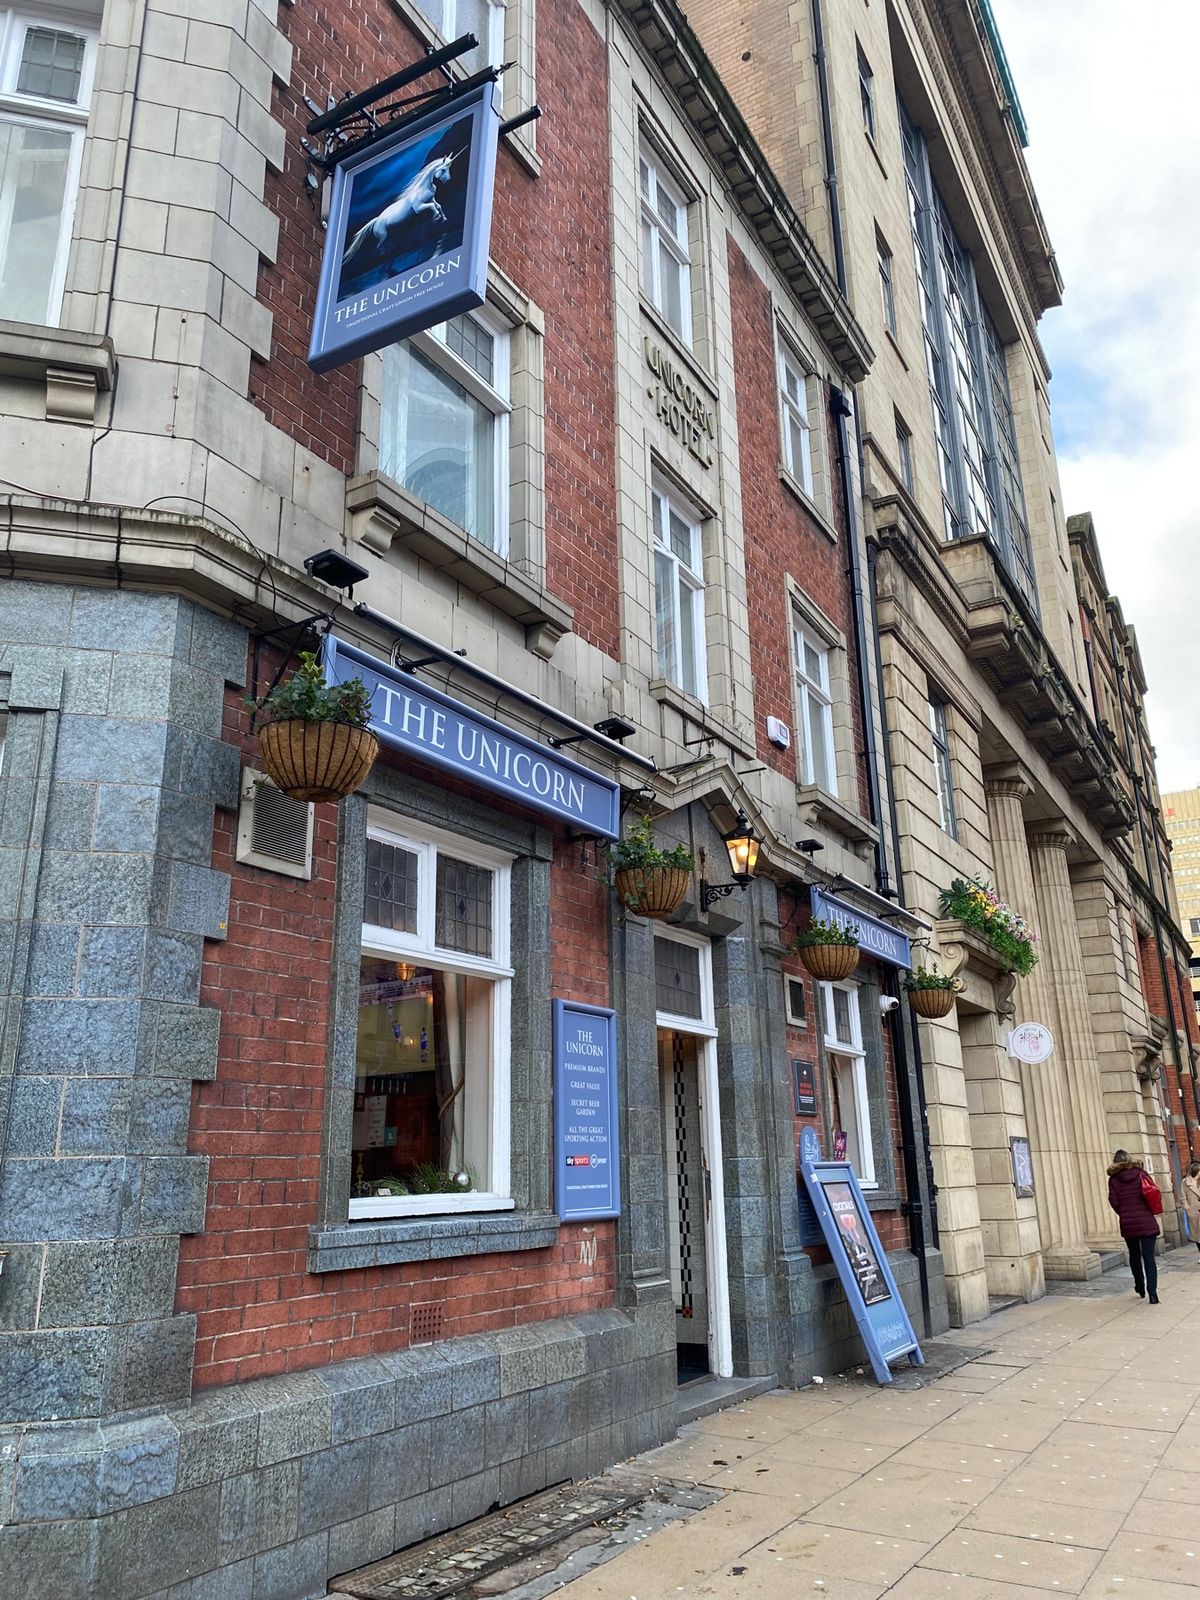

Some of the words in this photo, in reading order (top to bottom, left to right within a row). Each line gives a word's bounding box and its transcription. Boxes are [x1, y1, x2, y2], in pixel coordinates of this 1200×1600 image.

[335, 297, 368, 323] THE
[374, 255, 461, 306] UNICORN
[644, 336, 714, 440] UNICORN
[655, 386, 710, 470] HOTEL
[378, 683, 445, 749] THE
[457, 721, 586, 813] UNICORN
[577, 1029, 592, 1043] THE
[566, 1041, 604, 1057] UNICORN
[564, 1062, 587, 1072] PREMIUM
[587, 1065, 606, 1074] BRANDS
[570, 1099, 588, 1107] SECRET
[564, 1134, 589, 1143] SPORTING
